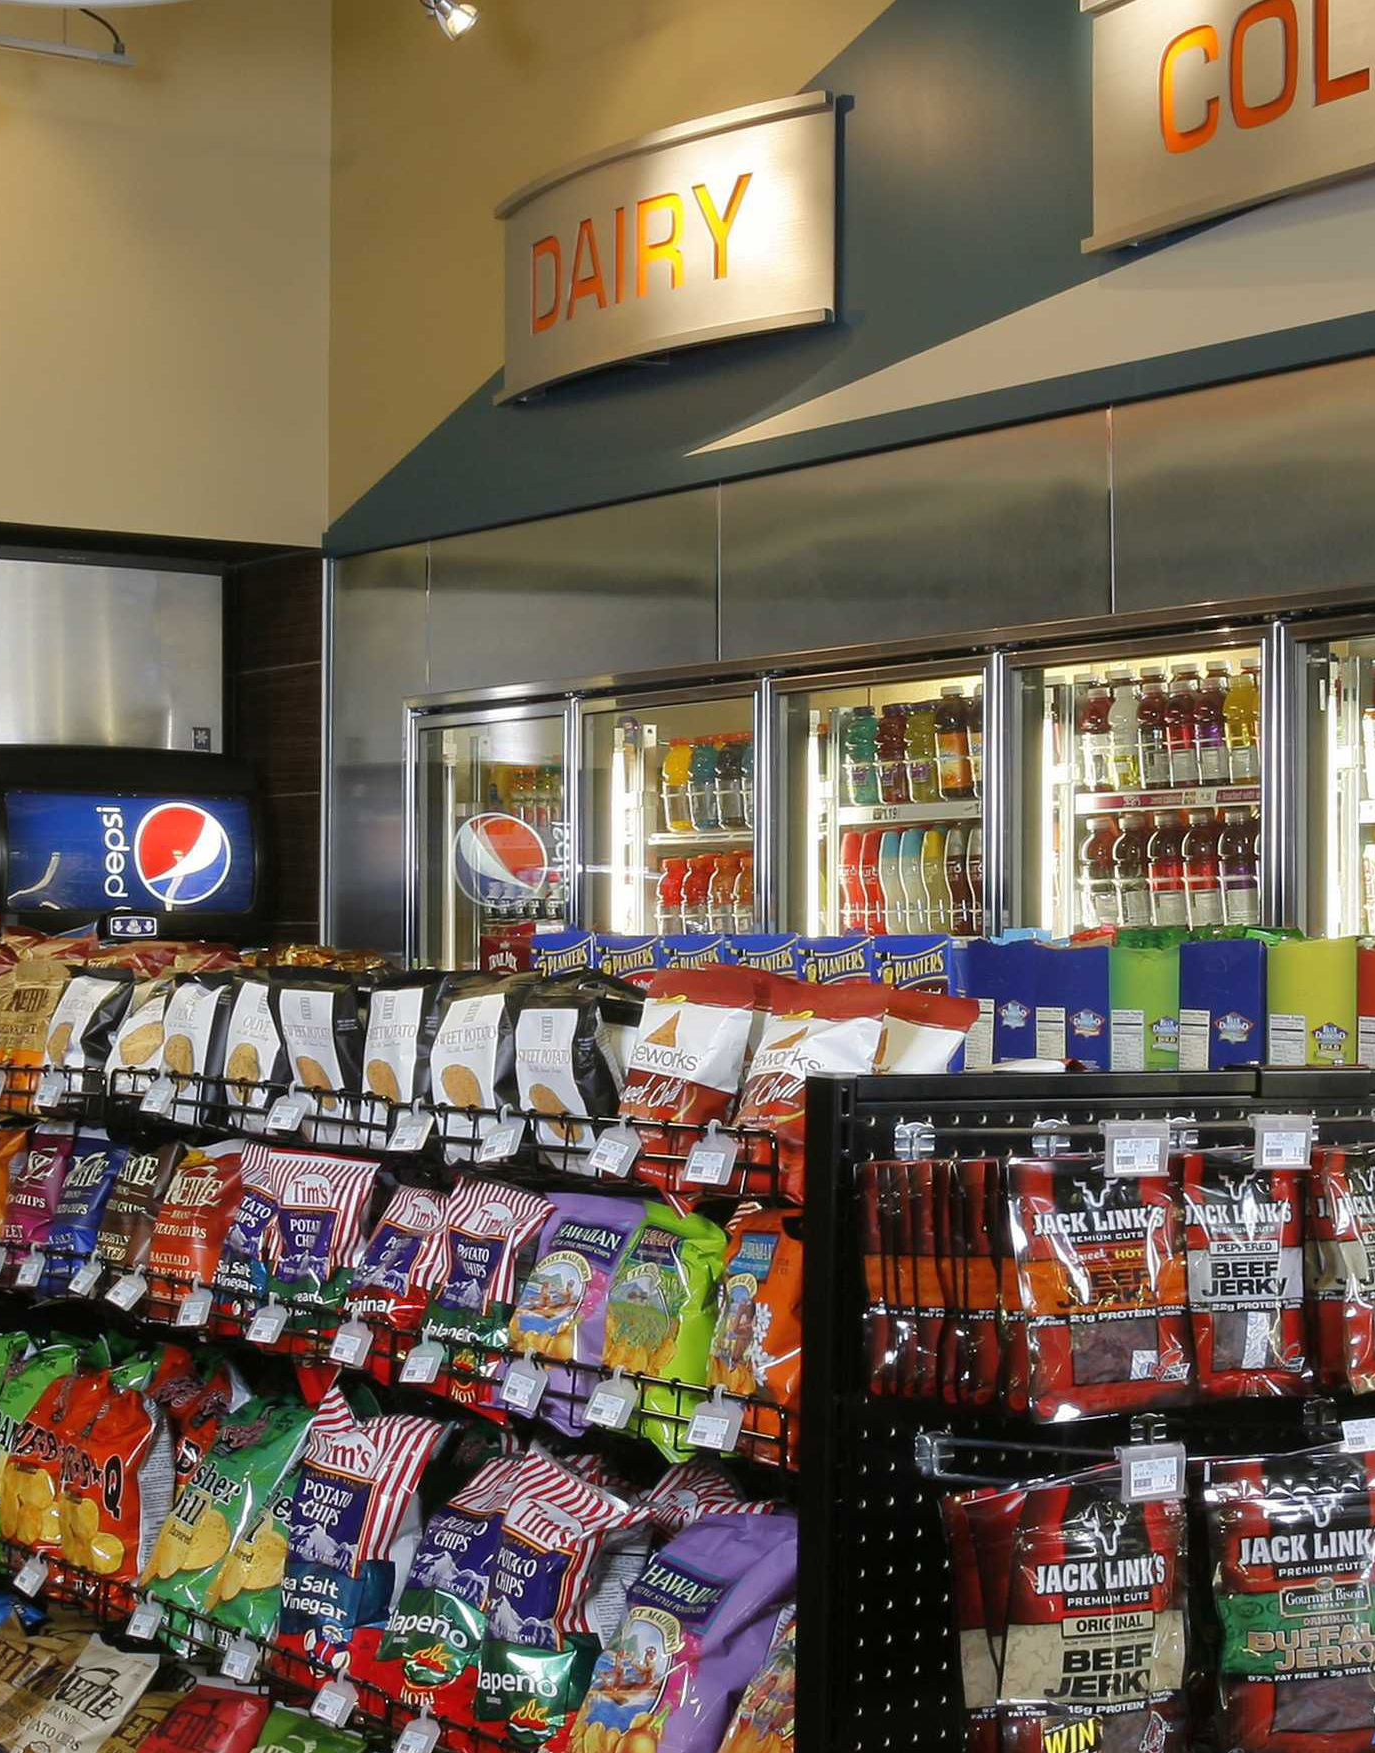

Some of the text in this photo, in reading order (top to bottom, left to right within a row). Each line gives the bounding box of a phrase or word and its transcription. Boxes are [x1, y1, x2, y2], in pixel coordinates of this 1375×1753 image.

[528, 170, 753, 333] DAIRY
[96, 806, 129, 897] pepsi
[548, 946, 588, 974] PLANTERS
[613, 947, 653, 974] PLANTERS
[818, 952, 865, 980] PLANTERS
[896, 951, 944, 982] PLANTERS
[292, 1178, 329, 1203] Tim's
[1034, 1205, 1165, 1236] JACK LINK'S
[1116, 1231, 1144, 1241] CUTS
[1216, 1243, 1272, 1252] PEPPERED
[1115, 1249, 1144, 1259] HOT
[1212, 1261, 1279, 1278] BEEF
[1202, 1277, 1288, 1296] JERKY
[1070, 1308, 1156, 1324] 21g PROTEIN
[1212, 1301, 1281, 1312] 22g PROTEIN
[190, 1461, 242, 1505] sher
[302, 1479, 353, 1508] POTATO
[299, 1501, 340, 1526] CHIPS
[514, 1501, 571, 1549] Tim's
[434, 1529, 472, 1552] CHIPS
[1241, 1535, 1307, 1566] JACK
[497, 1547, 538, 1578] POTATO
[1036, 1556, 1165, 1594] JACK LINK'S
[1278, 1562, 1368, 1577] PREMIUM CUTS
[301, 1574, 339, 1599] Salt
[495, 1573, 525, 1599] CHIPS
[1286, 1587, 1364, 1606] Gourmet Bison
[282, 1591, 347, 1621] Vinegar
[1067, 1592, 1149, 1607] PREMIUM CUTS
[1307, 1602, 1345, 1611] COMPANY
[1076, 1615, 1143, 1633] ORIGINAL
[1304, 1614, 1353, 1626] ORIGINAL
[1063, 1645, 1152, 1673] BEEF
[1045, 1671, 1150, 1699] JERKY
[1275, 1673, 1292, 1681] FAT
[1295, 1671, 1319, 1680] FREE
[1330, 1669, 1342, 1678] 3g
[1345, 1667, 1371, 1675] TOTAL
[1067, 1701, 1144, 1716] 15g PROTEIN
[1044, 1717, 1095, 1753] WIN
